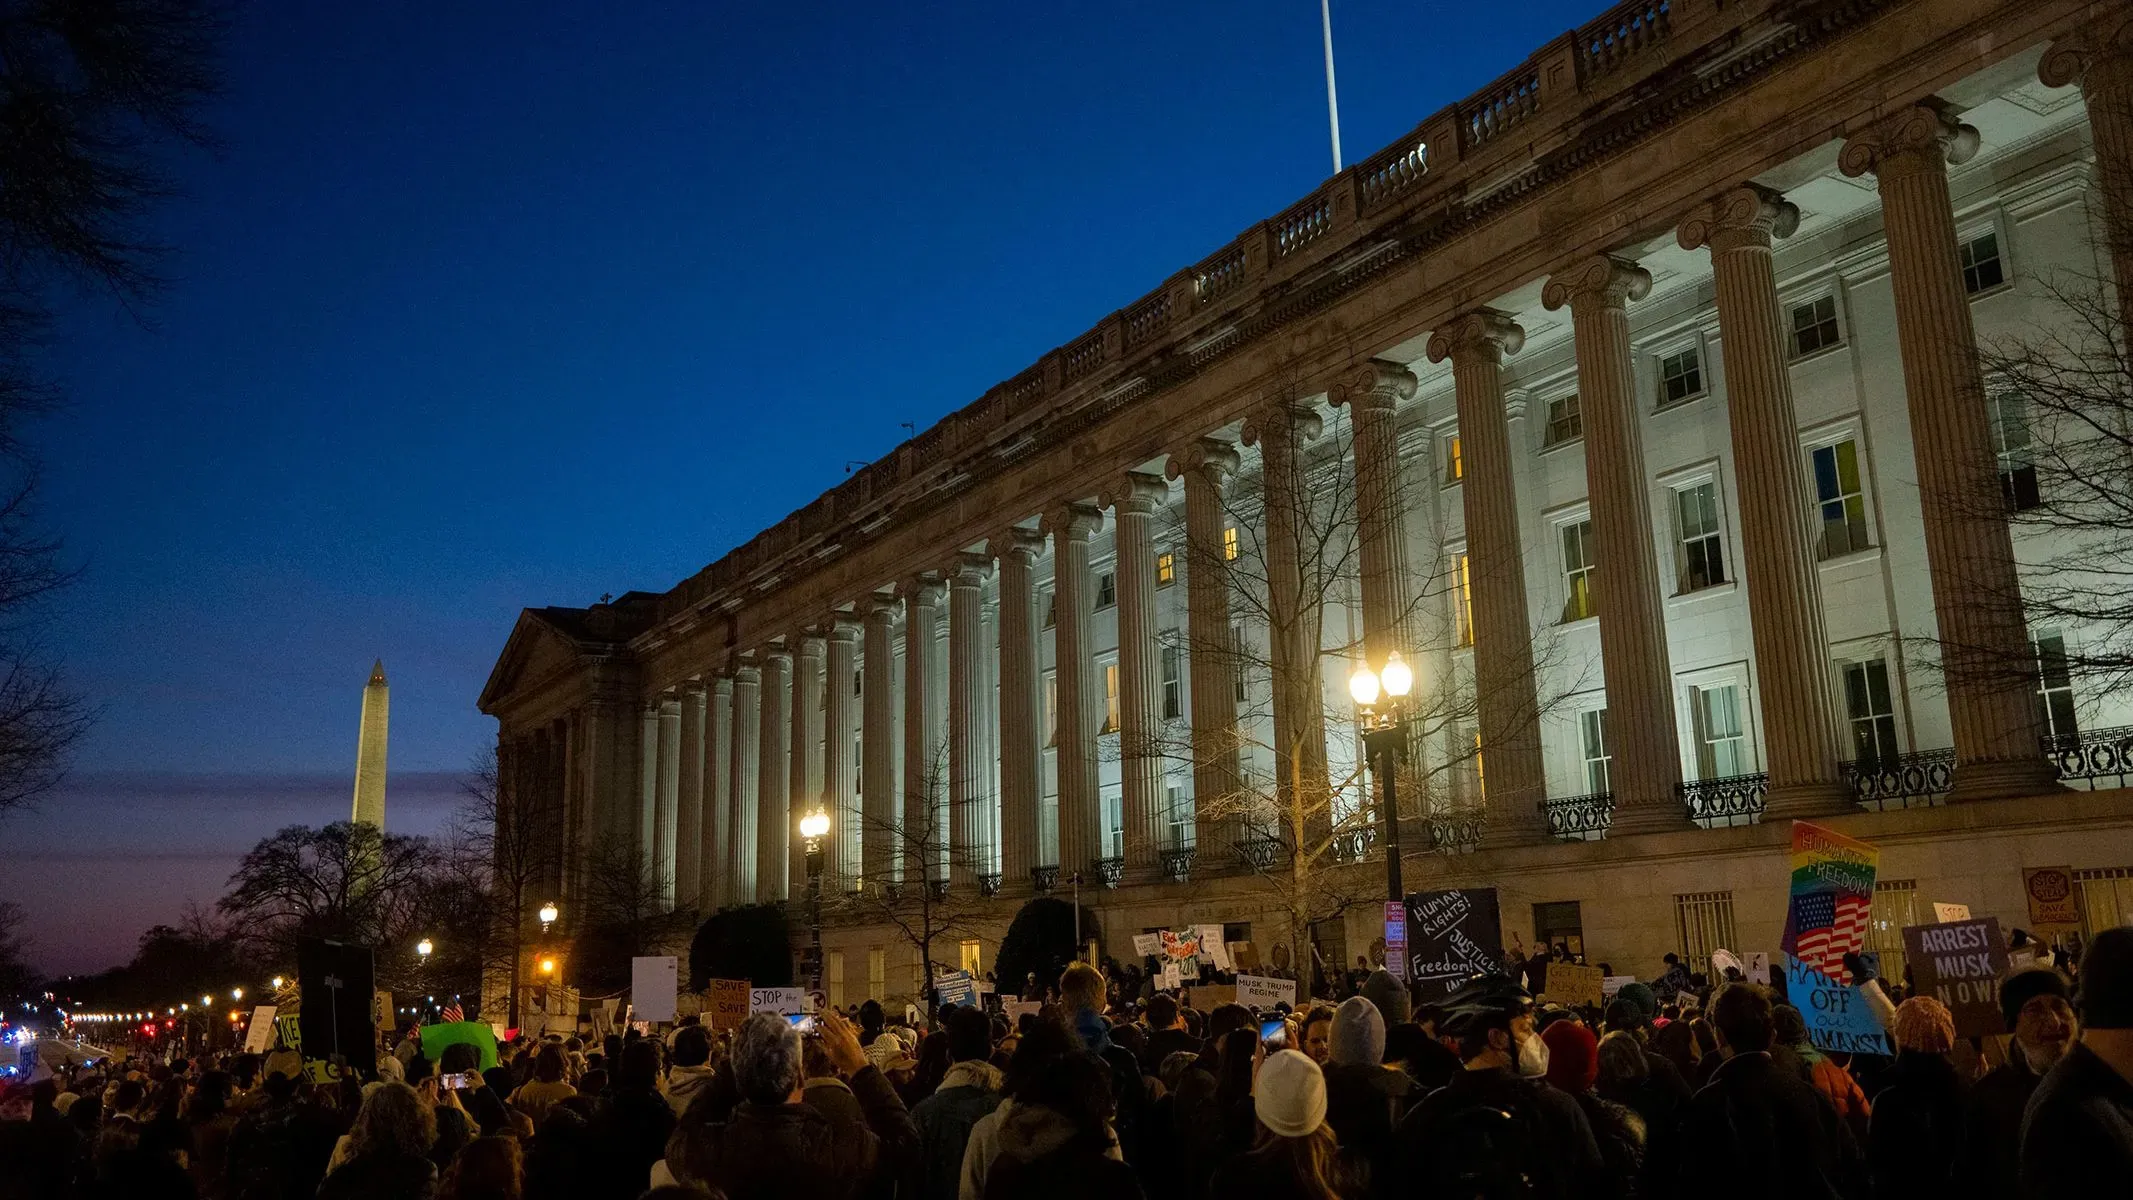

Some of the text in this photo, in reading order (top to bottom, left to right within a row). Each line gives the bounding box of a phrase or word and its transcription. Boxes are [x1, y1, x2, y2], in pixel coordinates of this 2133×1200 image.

[1807, 855, 1868, 898] FREEDOM
[1413, 889, 1461, 921] HUMAN
[1921, 924, 1989, 953] ARREST
[1412, 952, 1473, 976] Freedom!
[1934, 953, 1996, 979] MUSK
[715, 980, 745, 992] SAVE
[1239, 979, 1294, 991] MUSK TRUMP
[1249, 988, 1280, 998] REGIME
[718, 1001, 746, 1014] SAVE
[752, 990, 797, 1006] STOP the
[1810, 989, 1851, 1013] OFF
